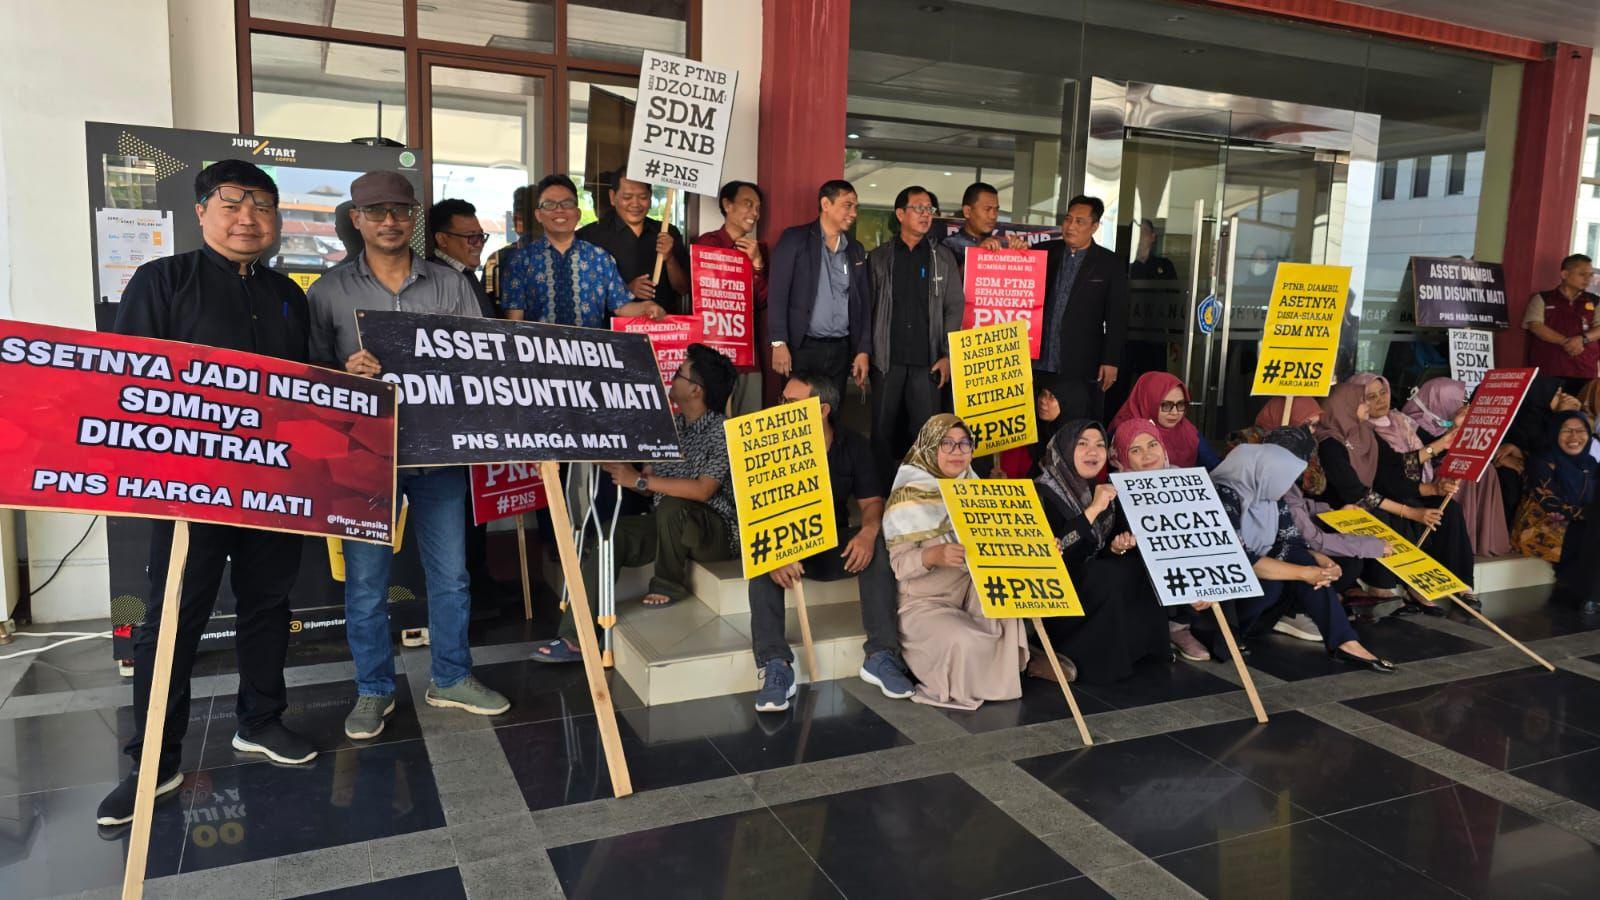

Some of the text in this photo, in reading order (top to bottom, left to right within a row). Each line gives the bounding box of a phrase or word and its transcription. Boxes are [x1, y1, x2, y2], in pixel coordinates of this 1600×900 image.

[650, 57, 727, 85] P3K PTNB
[655, 77, 725, 104] DZOLIM
[647, 95, 717, 131] SDM
[231, 138, 259, 148] JUMP
[643, 123, 715, 155] PTNB
[263, 147, 296, 158] START
[645, 159, 699, 182] #PNS
[975, 277, 1035, 289] SDM PTNB
[1430, 264, 1495, 283] ASSET DIAMBIL
[721, 279, 745, 291] PTNB
[1420, 285, 1505, 304] SDM DISUNTIK MATI
[702, 298, 746, 312] DIANGKAT
[975, 297, 1035, 308] DIANGKAT
[1279, 295, 1337, 309] ASETNYA
[702, 312, 745, 337] PNS
[1277, 311, 1333, 321] DISIA-SIAKAN
[961, 327, 1018, 348] 13 TAHUN
[1274, 324, 1330, 337] SDM NYA
[415, 328, 624, 369] ASSET DIAMBIL
[658, 349, 687, 360] PTN
[963, 341, 1020, 361] NASIB KAMI
[964, 354, 1020, 377] DIPUTAR
[1262, 359, 1323, 384] #PNS
[1456, 353, 1488, 368] SDM
[965, 369, 1023, 389] PUTAR KAYA
[1457, 369, 1484, 382] PTN
[181, 360, 258, 393] JADI
[268, 375, 379, 417] NEGERI
[382, 373, 662, 411] SDM DISUNTIK MATI
[967, 383, 1025, 407] KITIRAN
[120, 387, 261, 430] SDMnya
[738, 407, 809, 437] 13 TAHUN
[79, 418, 290, 468] DIKONTRAK
[452, 433, 628, 450] PNS HARGA MATI
[743, 424, 812, 452] NASIB KAMI
[1456, 428, 1498, 450] PNS
[744, 441, 814, 472] DIPUTAR
[747, 458, 817, 487] PUTAR KAYA
[1124, 475, 1204, 491] P3K PTNB
[33, 470, 312, 516] PNS HARGA MATI
[751, 475, 820, 511] KITIRAN
[953, 484, 1026, 497] 13 TAHUN
[1130, 488, 1212, 506] PRODUK
[497, 491, 536, 514] #PNS
[960, 499, 1033, 509] NASIB KAMI
[963, 511, 1038, 525] DIPUTAR
[1141, 510, 1222, 533] CACAT
[750, 514, 823, 565] #PNS
[970, 528, 1044, 537] PUTAR KAYA
[1147, 530, 1233, 552] HUKUM
[776, 537, 825, 561] HARGA MATI
[976, 542, 1052, 557] KITIRAN
[983, 576, 1065, 606] #PNS
[1163, 563, 1247, 597] #PNS
[1195, 584, 1253, 597] HARGA MATI
[1408, 568, 1451, 594] #PNS
[1014, 601, 1070, 609] HARGA MATI
